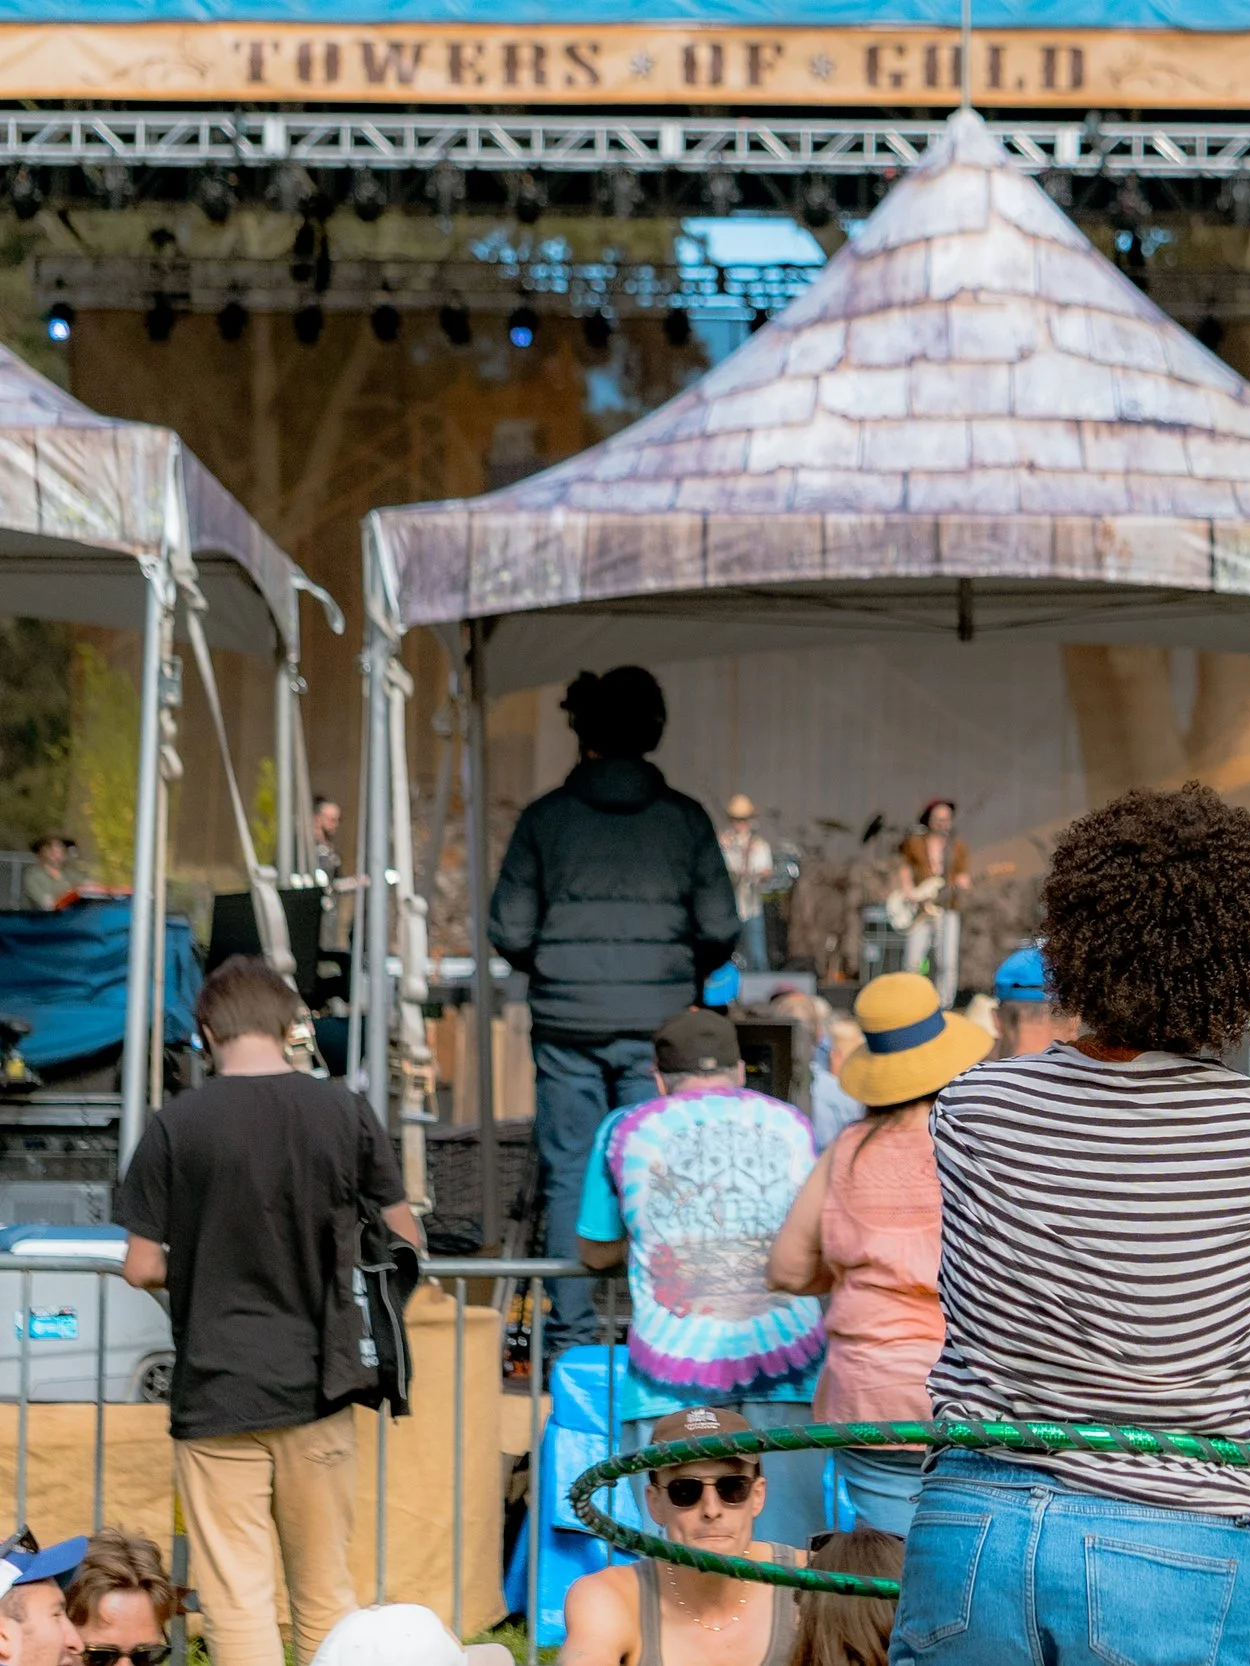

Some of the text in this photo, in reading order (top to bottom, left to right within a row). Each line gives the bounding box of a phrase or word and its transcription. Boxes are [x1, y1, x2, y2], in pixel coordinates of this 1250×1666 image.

[234, 41, 1085, 90] TOWERS OF GOLD
